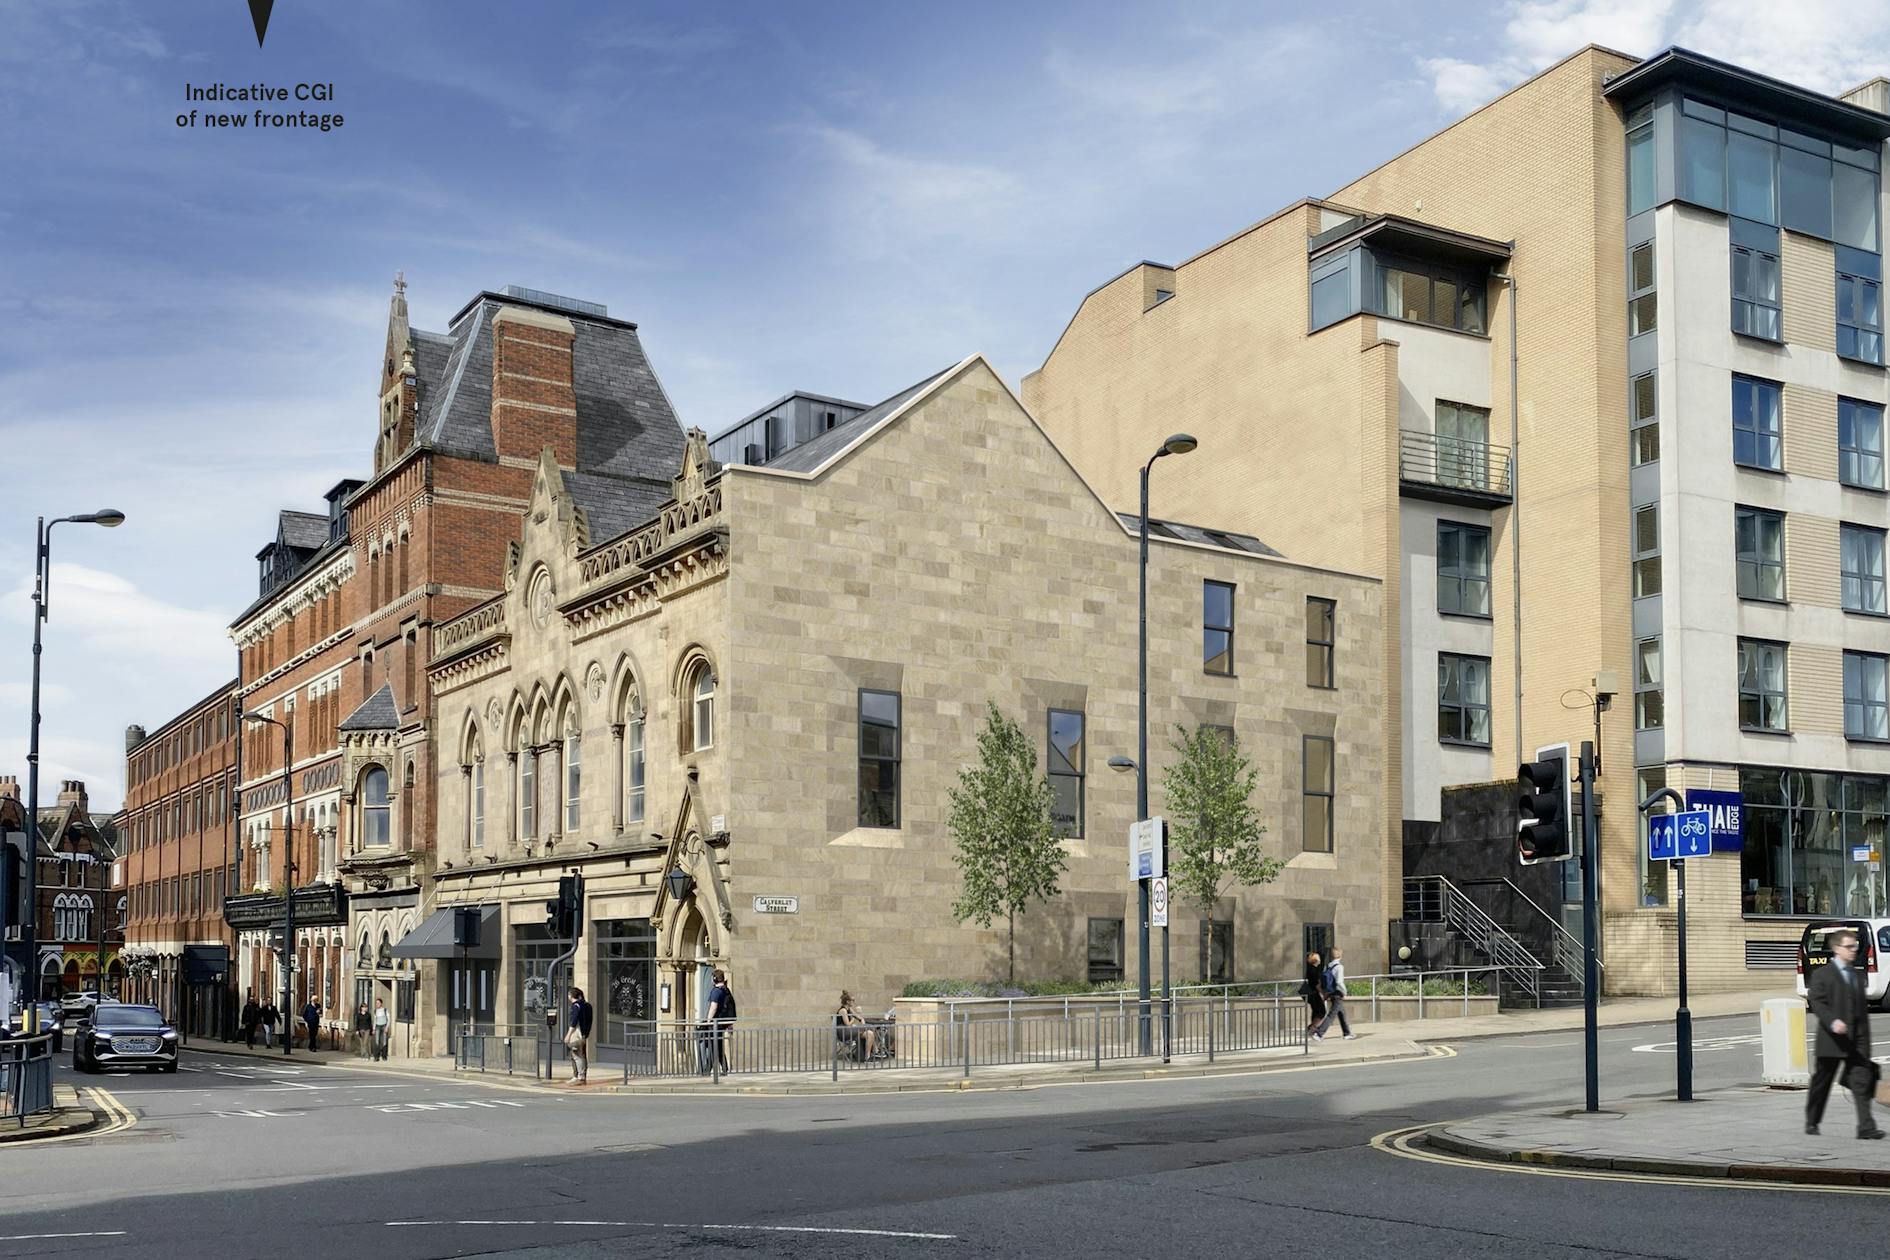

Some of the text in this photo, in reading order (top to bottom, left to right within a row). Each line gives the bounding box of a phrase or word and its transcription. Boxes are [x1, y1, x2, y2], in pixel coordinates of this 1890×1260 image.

[1731, 805, 1740, 830] EDGE
[1155, 890, 1164, 903] 20
[1809, 957, 1828, 965] TAXI
